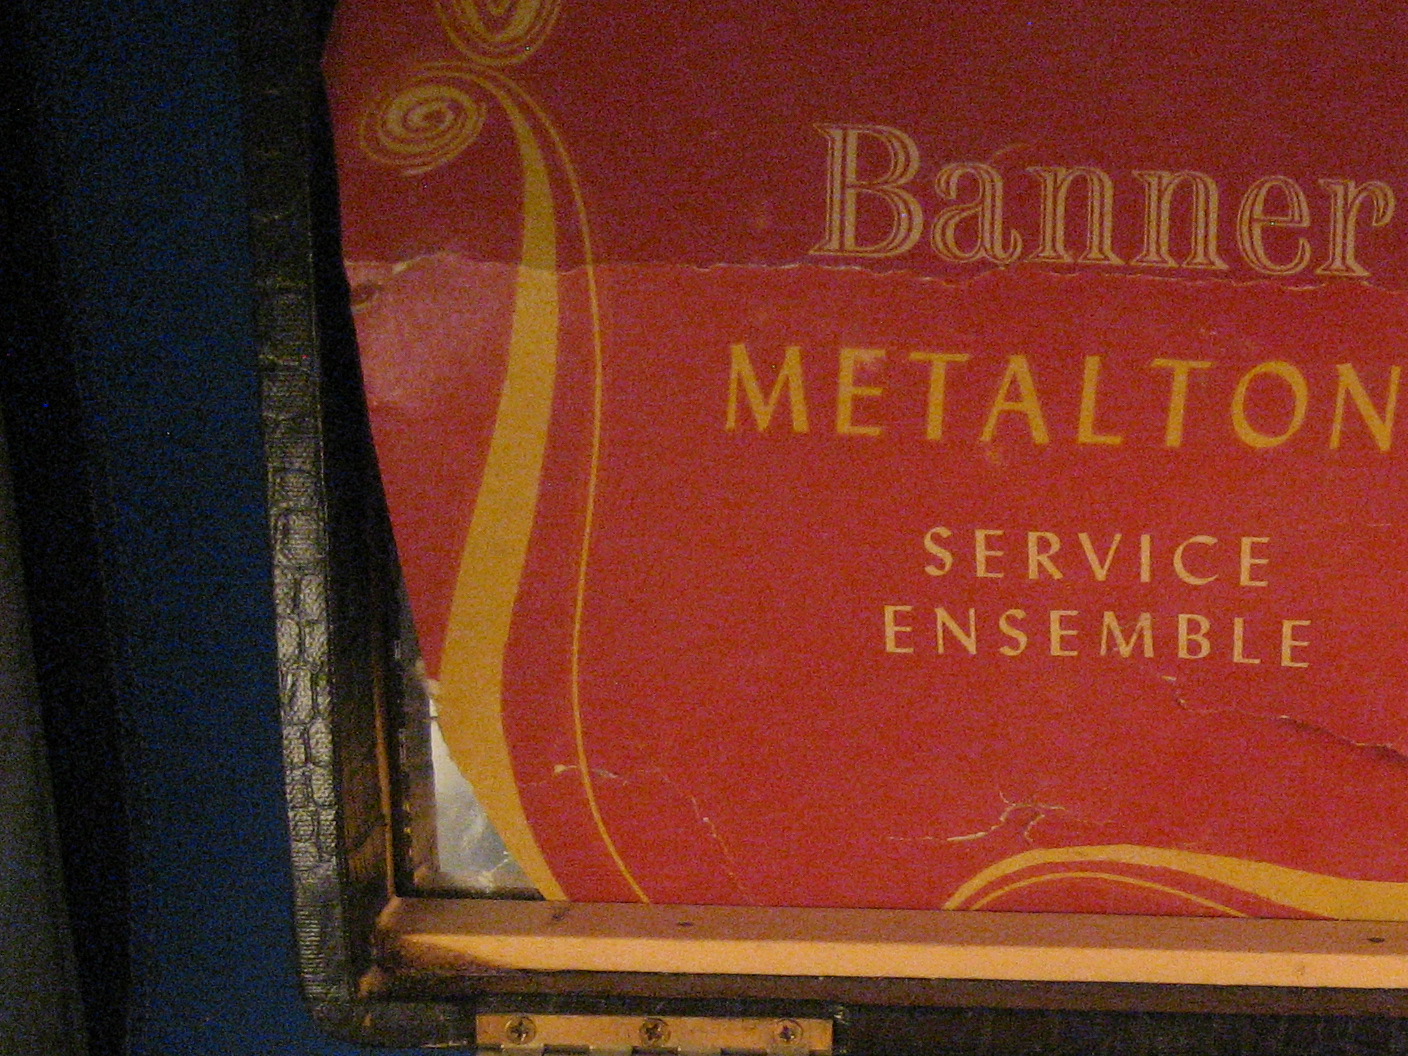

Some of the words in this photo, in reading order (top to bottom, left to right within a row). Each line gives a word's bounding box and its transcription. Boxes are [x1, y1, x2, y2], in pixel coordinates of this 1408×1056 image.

[810, 122, 1396, 278] Banner
[922, 526, 1272, 588] SERVICE
[882, 604, 1313, 669] ENSEMBLE
